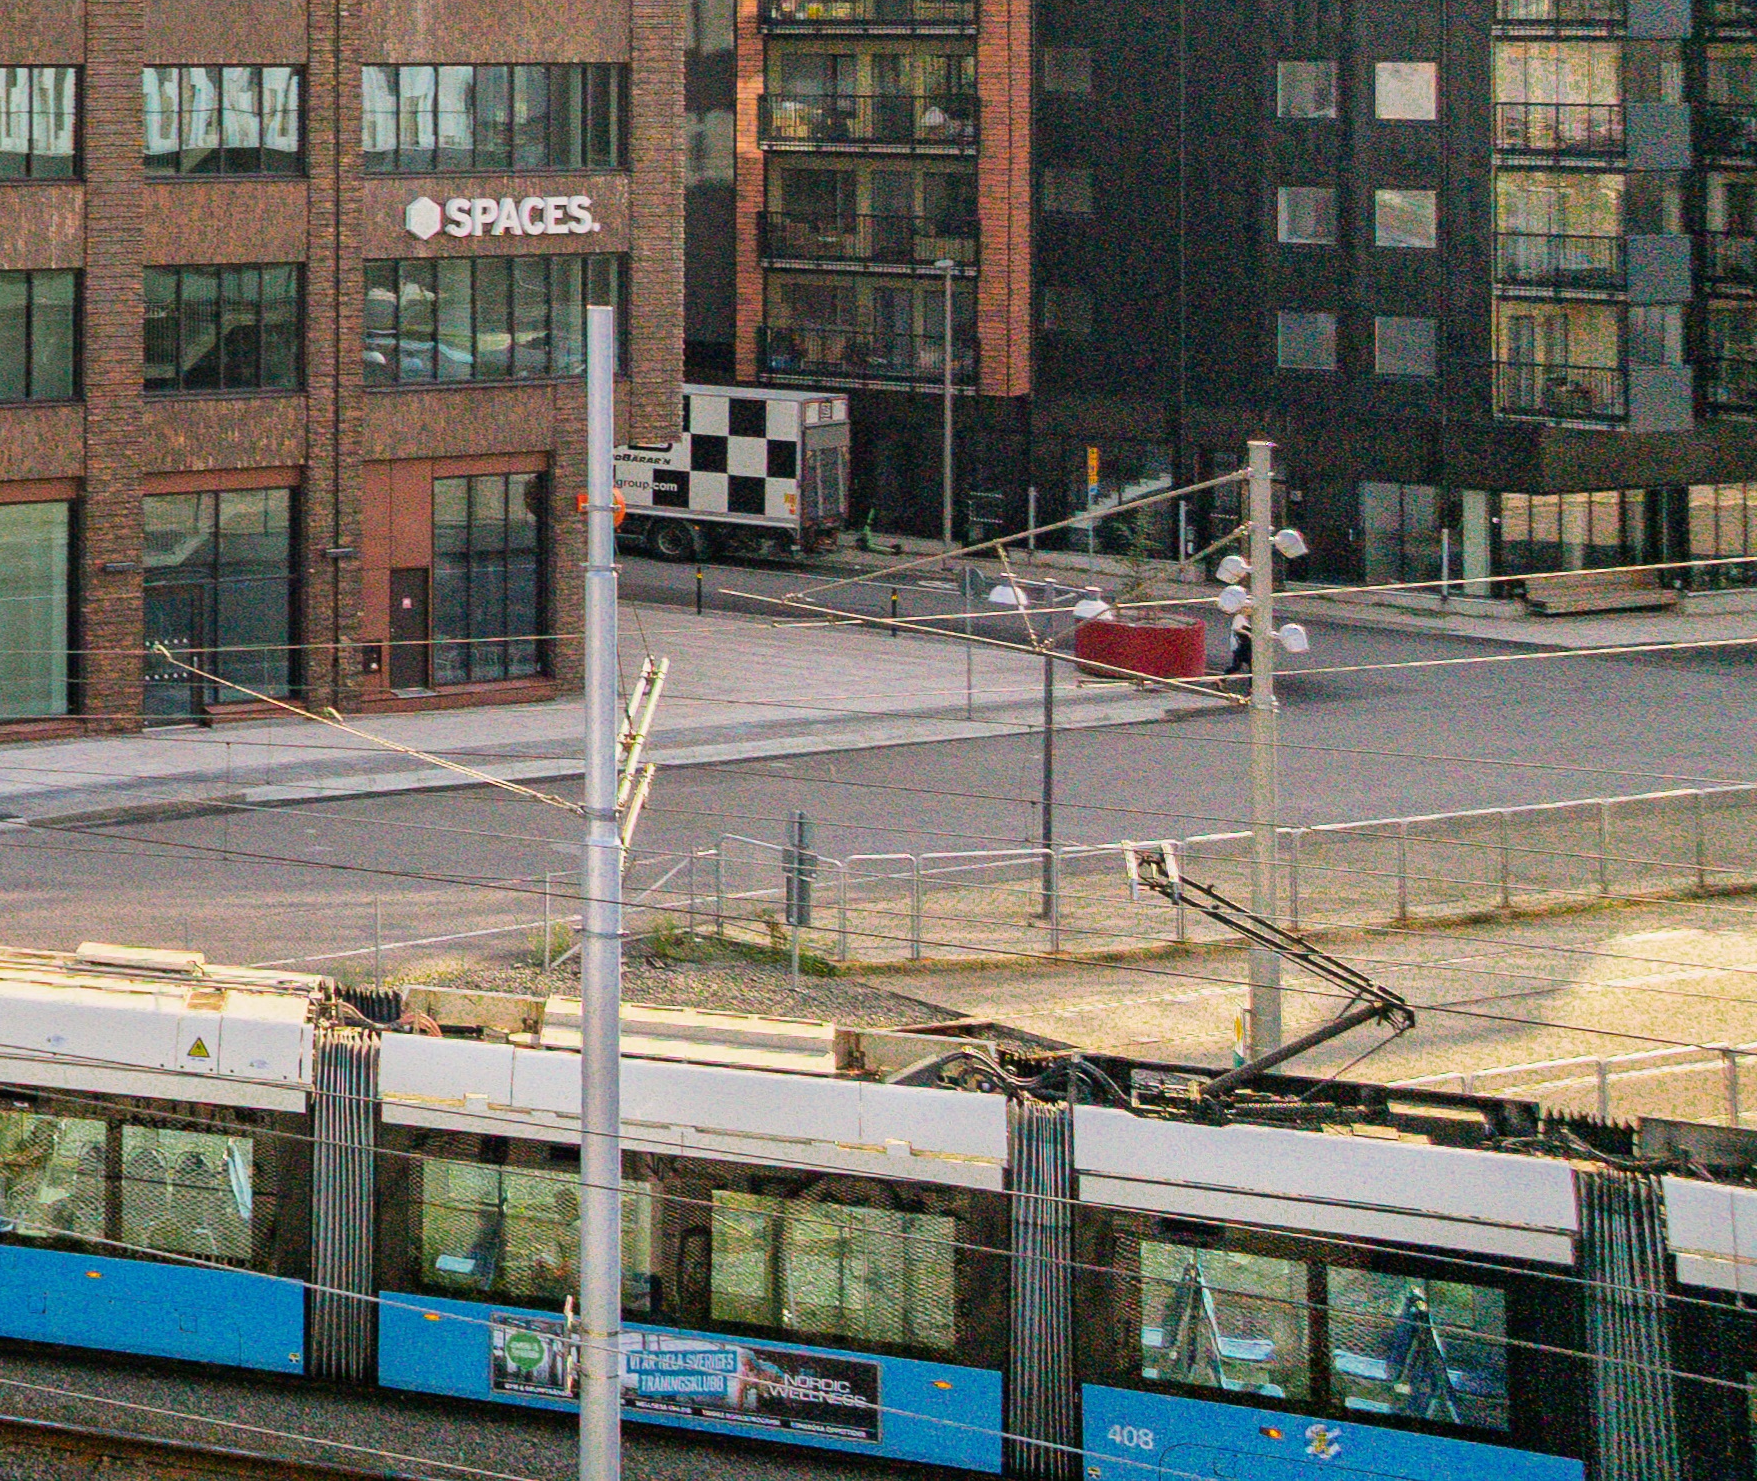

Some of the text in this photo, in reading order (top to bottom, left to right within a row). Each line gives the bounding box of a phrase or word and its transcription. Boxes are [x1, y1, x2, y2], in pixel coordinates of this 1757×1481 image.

[615, 479, 678, 491] group.com
[784, 1373, 851, 1394] NORDIC
[768, 1385, 868, 1408] WELLNESS
[1108, 1424, 1154, 1449] 408
